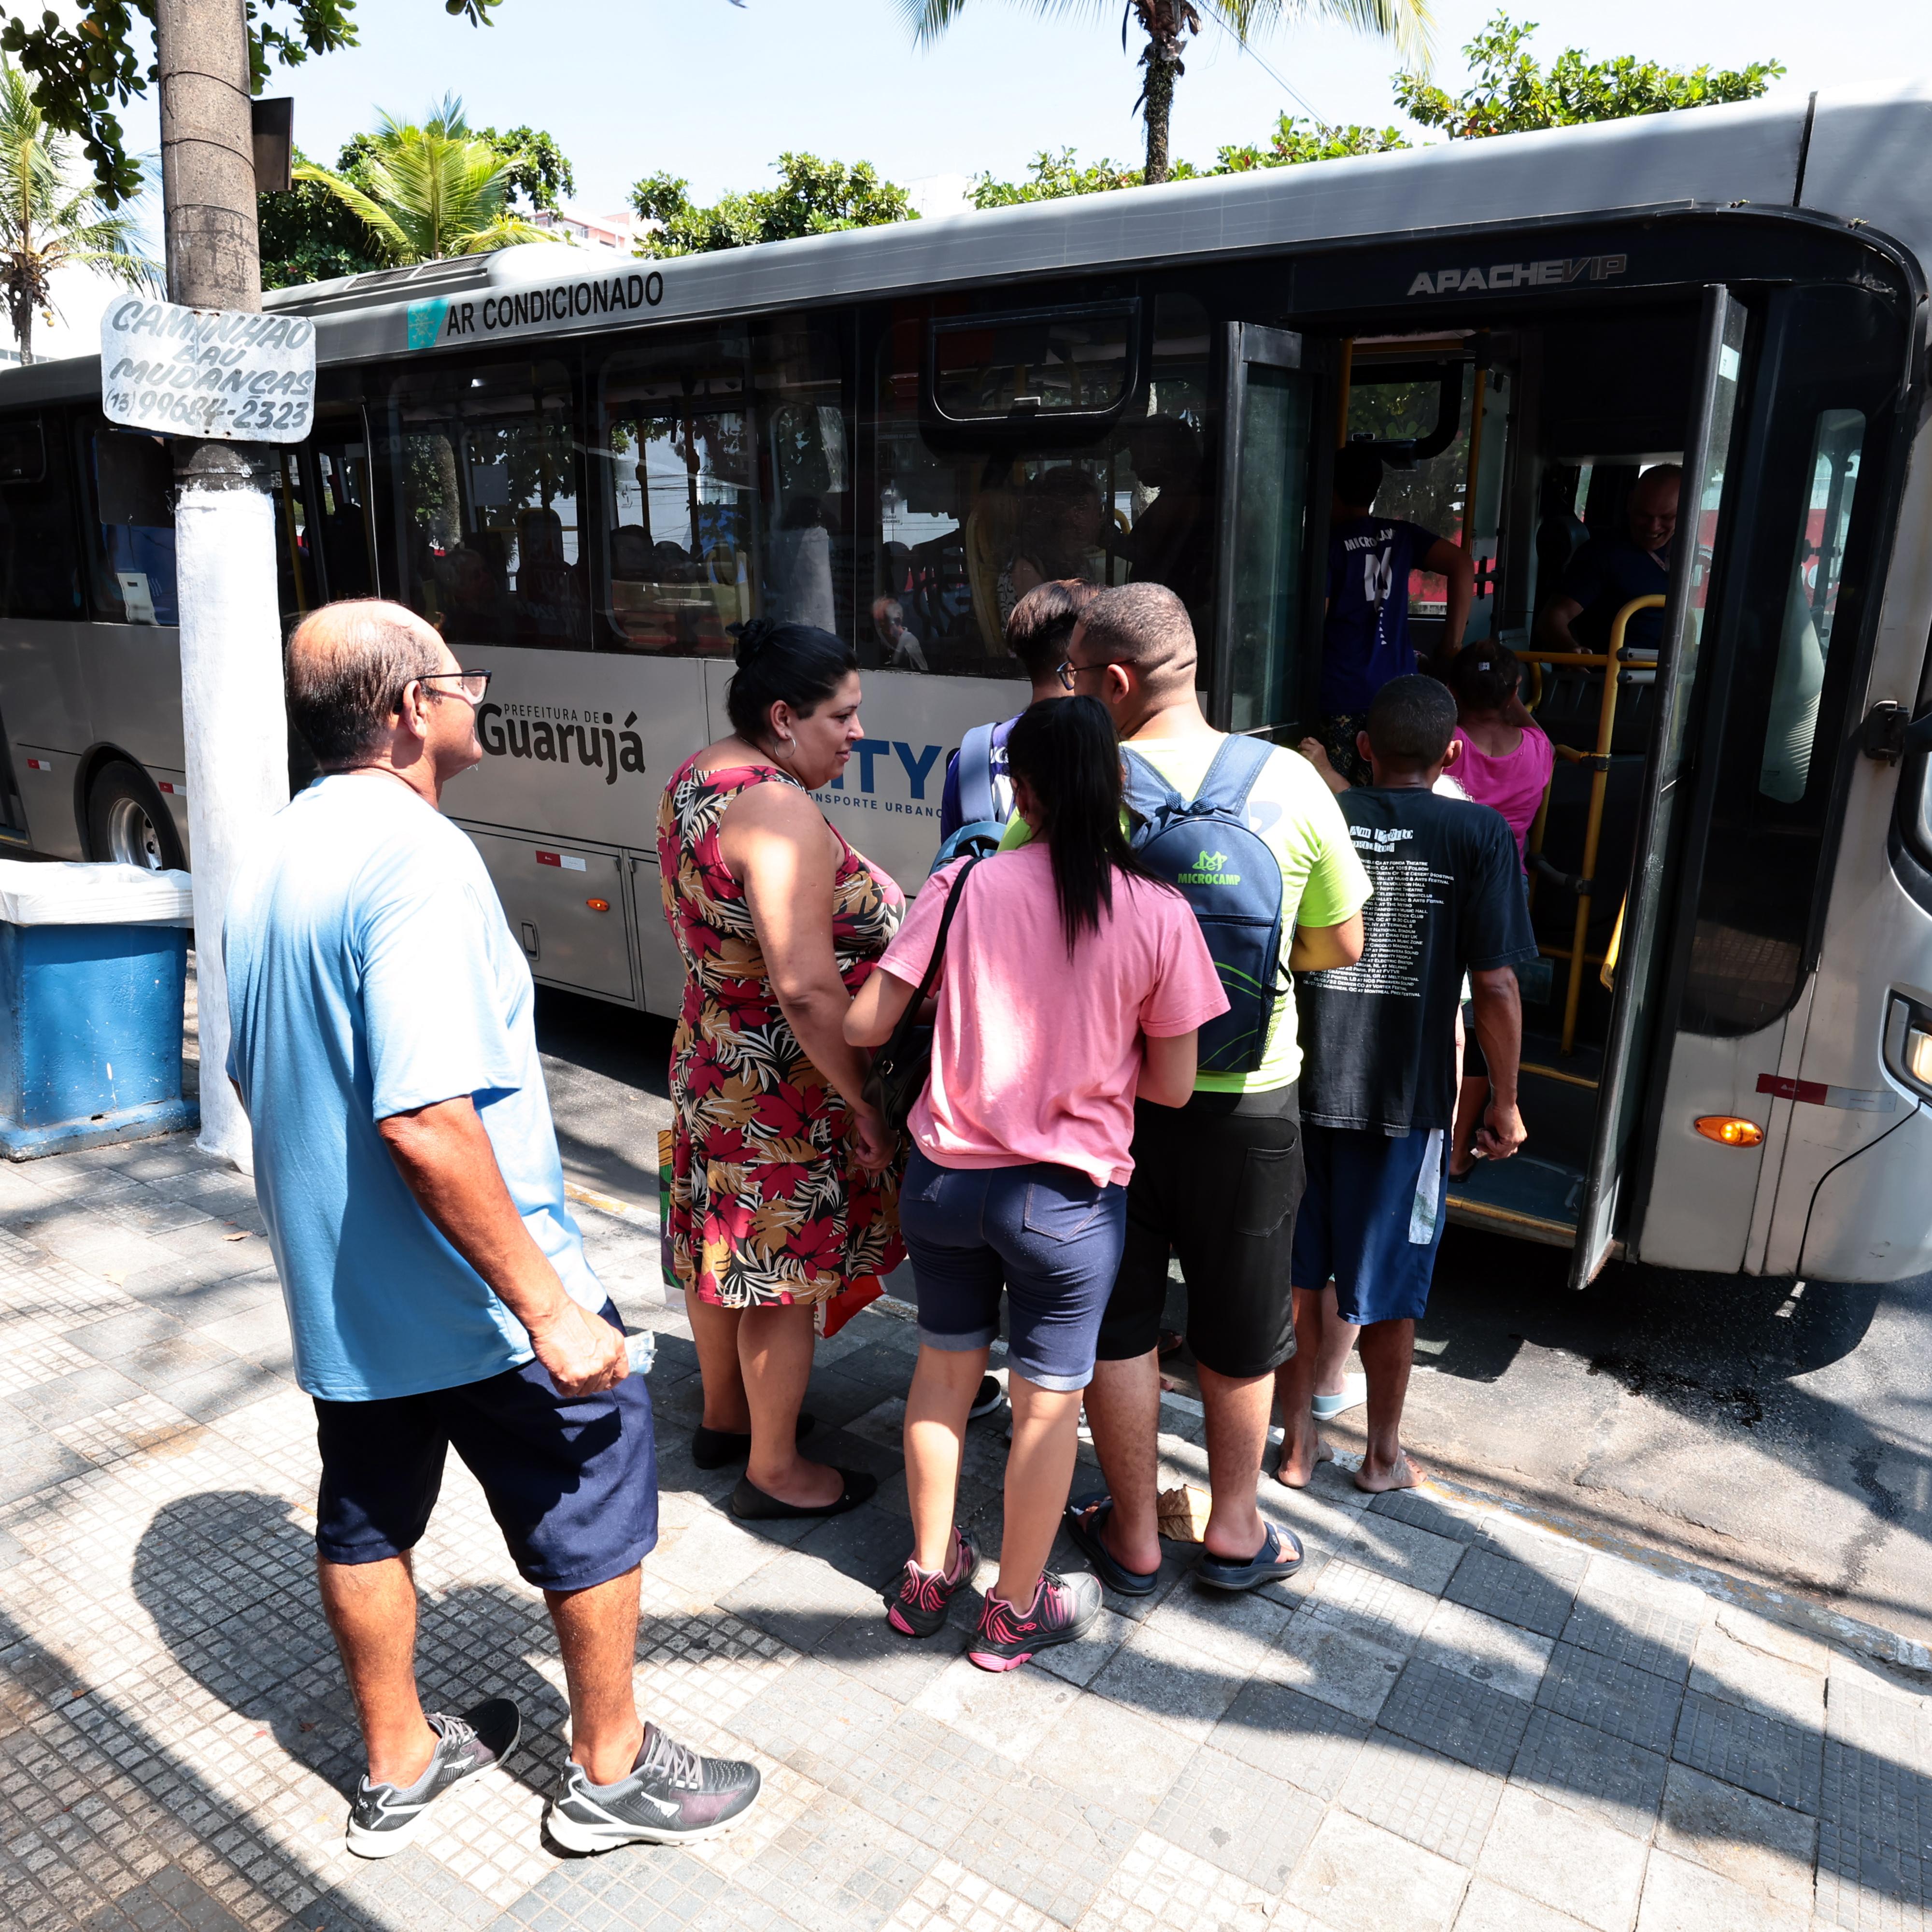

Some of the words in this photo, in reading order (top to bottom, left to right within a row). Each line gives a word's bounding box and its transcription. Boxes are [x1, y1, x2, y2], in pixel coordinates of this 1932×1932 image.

[447, 302, 474, 336] AR
[483, 271, 663, 330] CONDICIONADO
[104, 387, 136, 417] (13)
[139, 390, 309, 430] 99684-2323
[504, 704, 578, 721] PREFEITURA
[584, 710, 599, 724] DE
[477, 703, 646, 785] Guarujá
[831, 738, 943, 800] TY
[810, 793, 878, 810] NSPORTE
[1178, 873, 1241, 885] MICROCAMP
